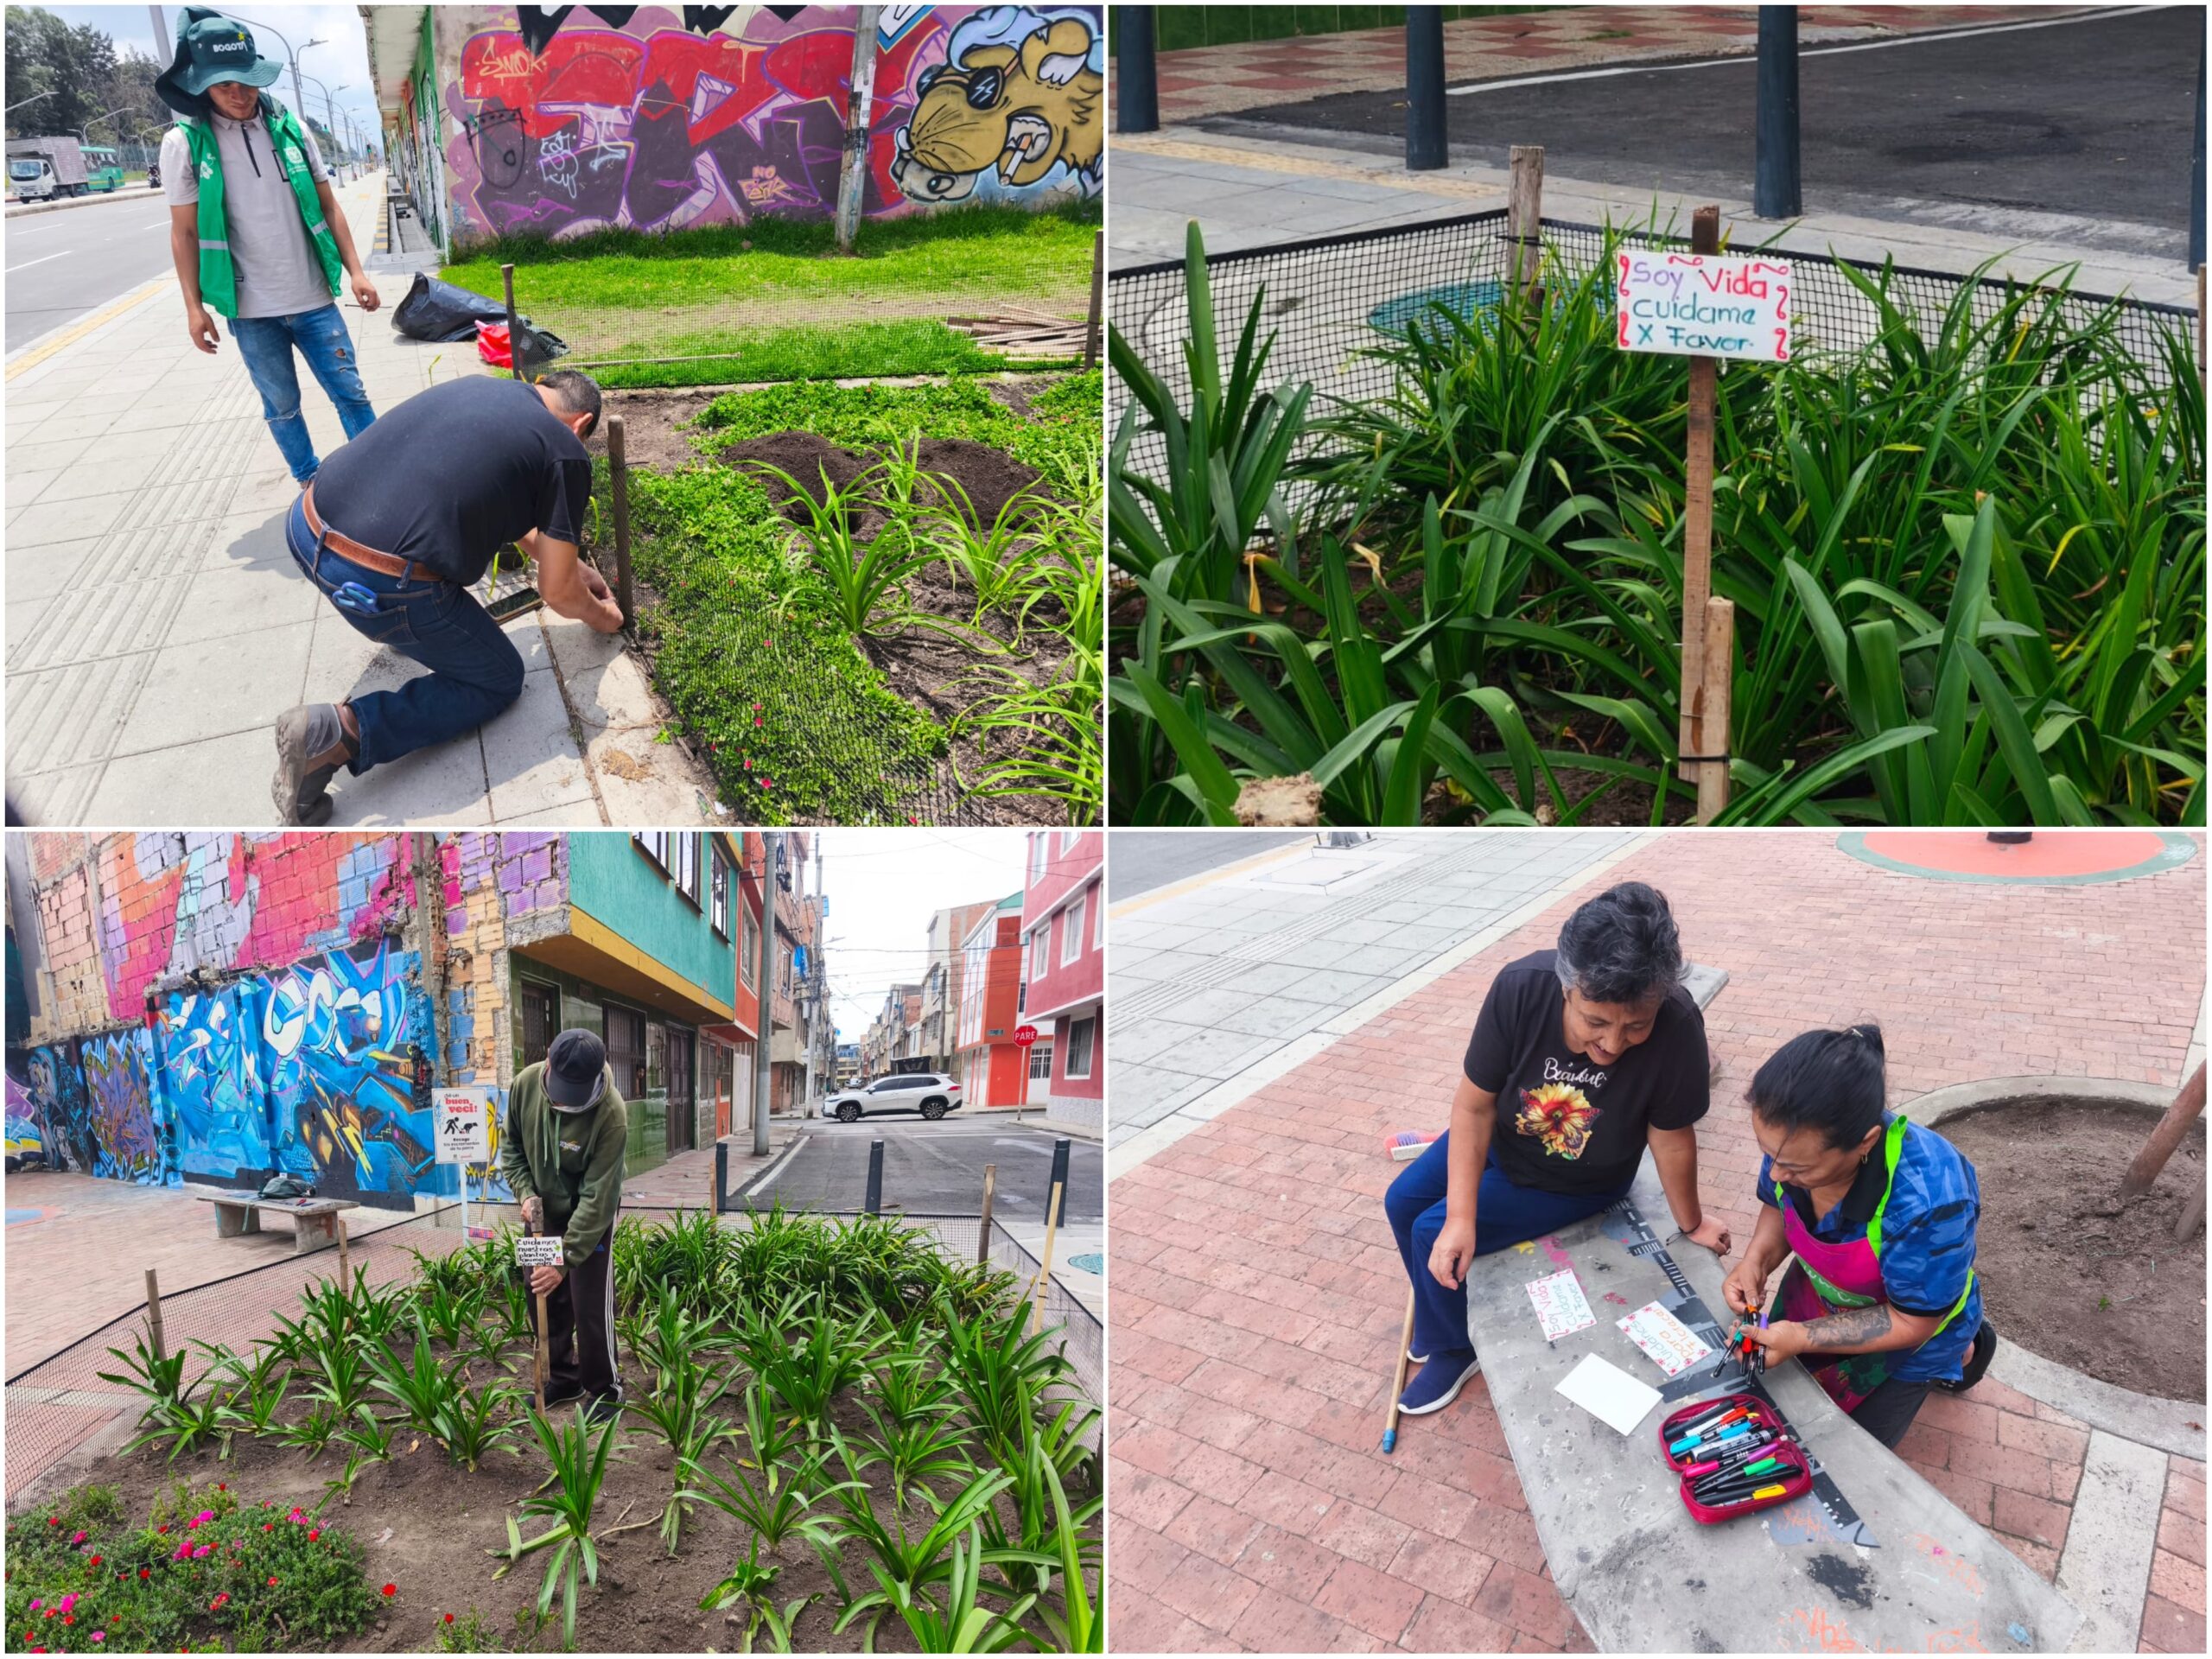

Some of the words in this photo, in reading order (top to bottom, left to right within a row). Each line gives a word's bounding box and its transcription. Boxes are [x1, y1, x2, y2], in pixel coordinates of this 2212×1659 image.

[1631, 261, 1684, 301] Soy
[1700, 264, 1768, 300] Vida
[1014, 1031, 1036, 1041] PARE
[448, 1103, 477, 1113] veci!
[1533, 1286, 1552, 1310] Vida
[1659, 1331, 1694, 1358] para
